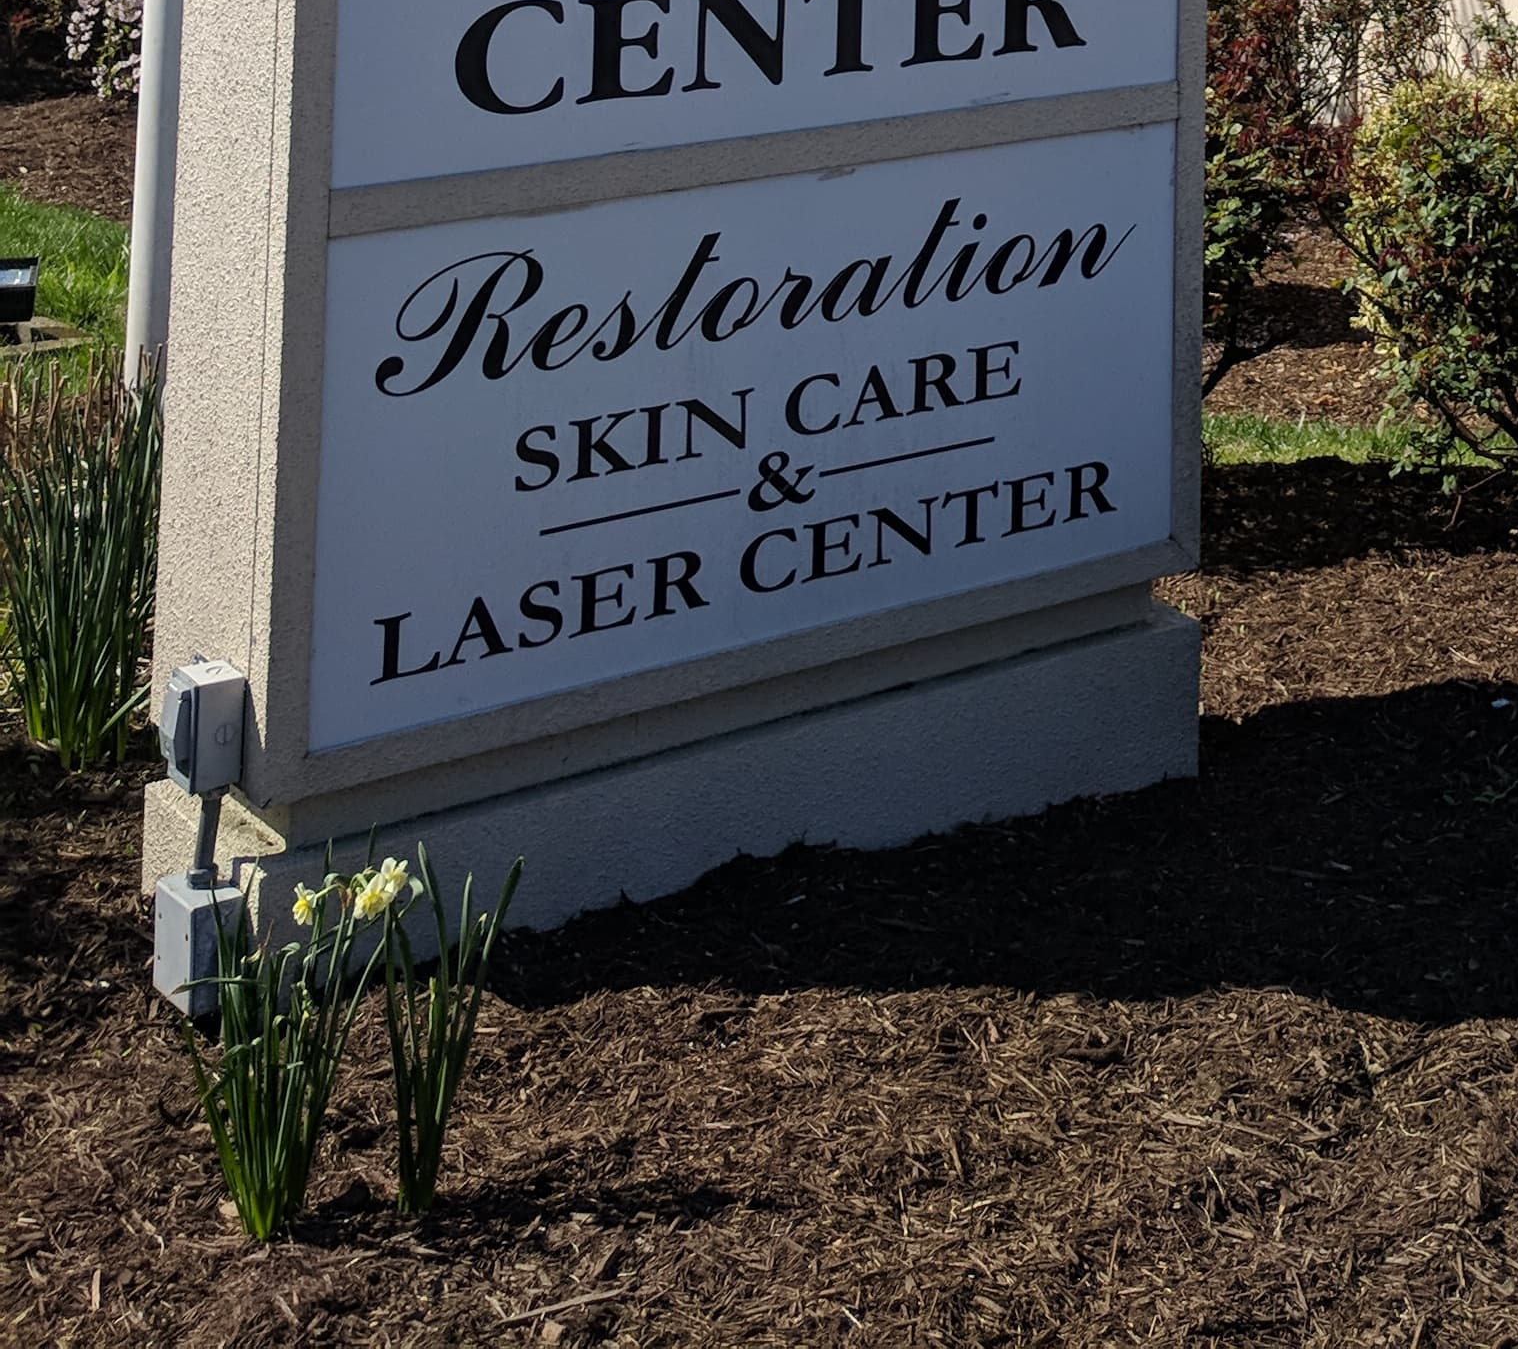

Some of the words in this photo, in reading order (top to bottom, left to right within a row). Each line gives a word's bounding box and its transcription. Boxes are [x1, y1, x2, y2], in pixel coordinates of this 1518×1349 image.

[374, 197, 1137, 398] Restoration
[514, 387, 755, 492] SKIN
[784, 340, 1022, 436] CARE
[747, 450, 816, 513] &
[369, 550, 711, 687] LASER
[739, 460, 1119, 594] CENTER
